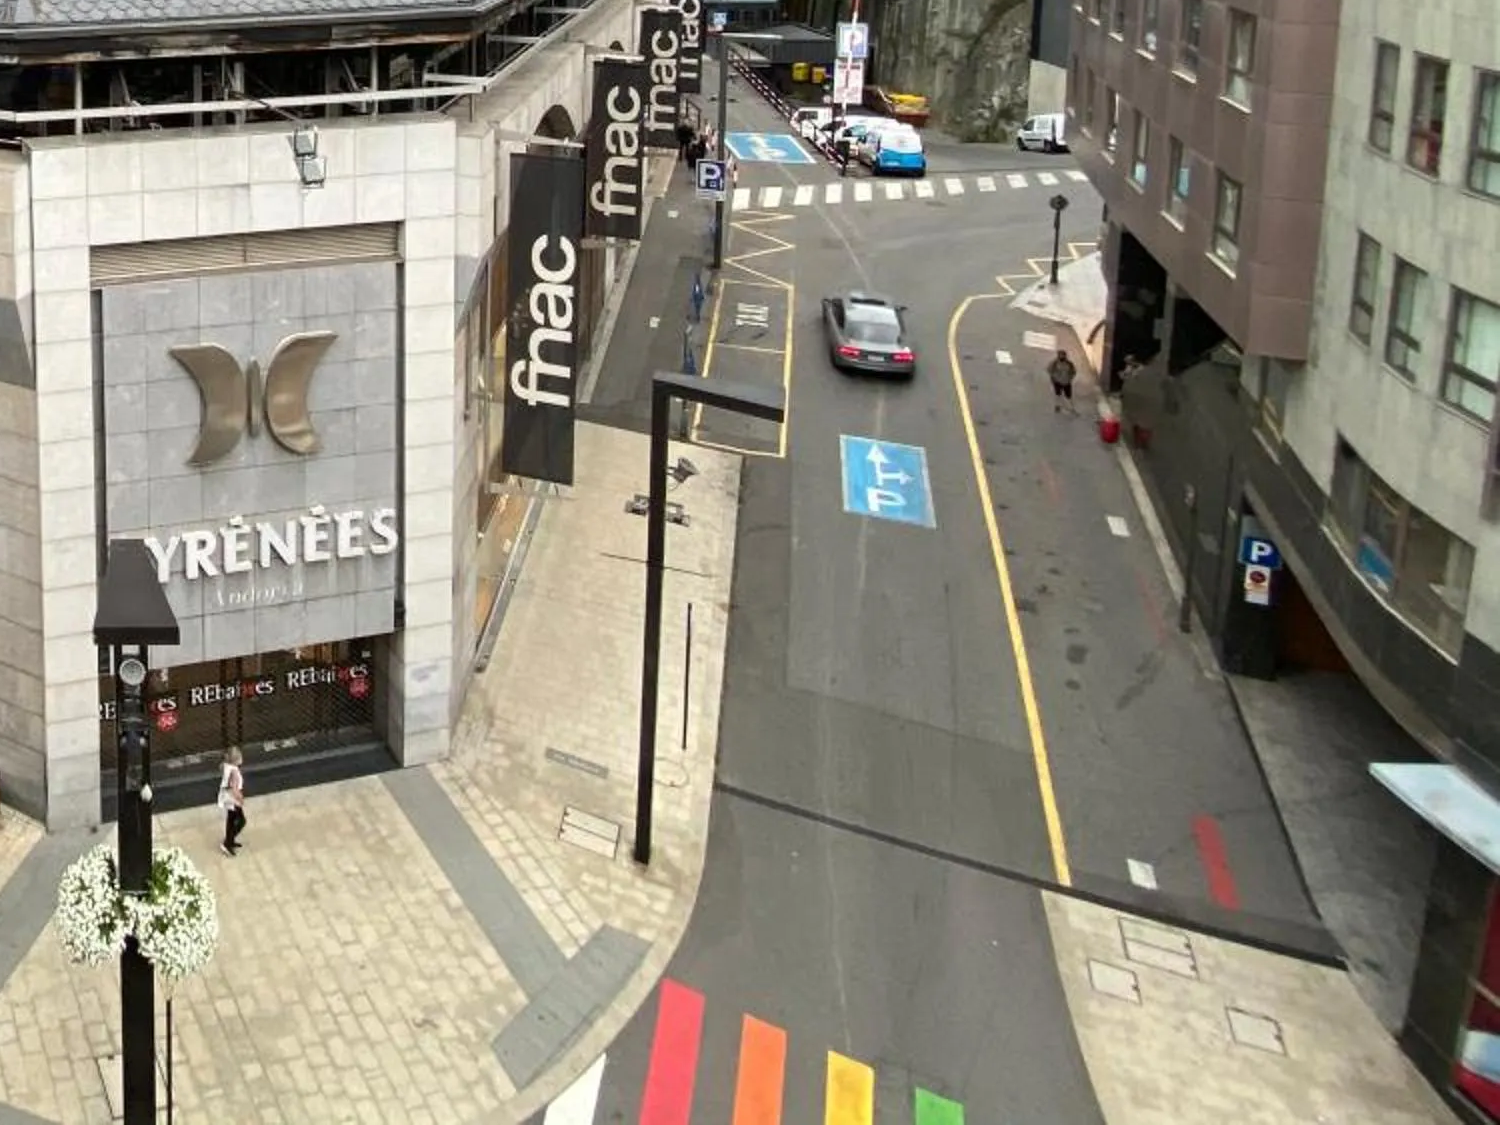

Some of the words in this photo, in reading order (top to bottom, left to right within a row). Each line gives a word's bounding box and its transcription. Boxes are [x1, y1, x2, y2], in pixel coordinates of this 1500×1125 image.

[590, 85, 642, 217] fnac
[699, 163, 722, 188] P
[511, 234, 577, 408] fnac
[144, 505, 398, 583] YRÉNÉES
[1250, 539, 1274, 563] P
